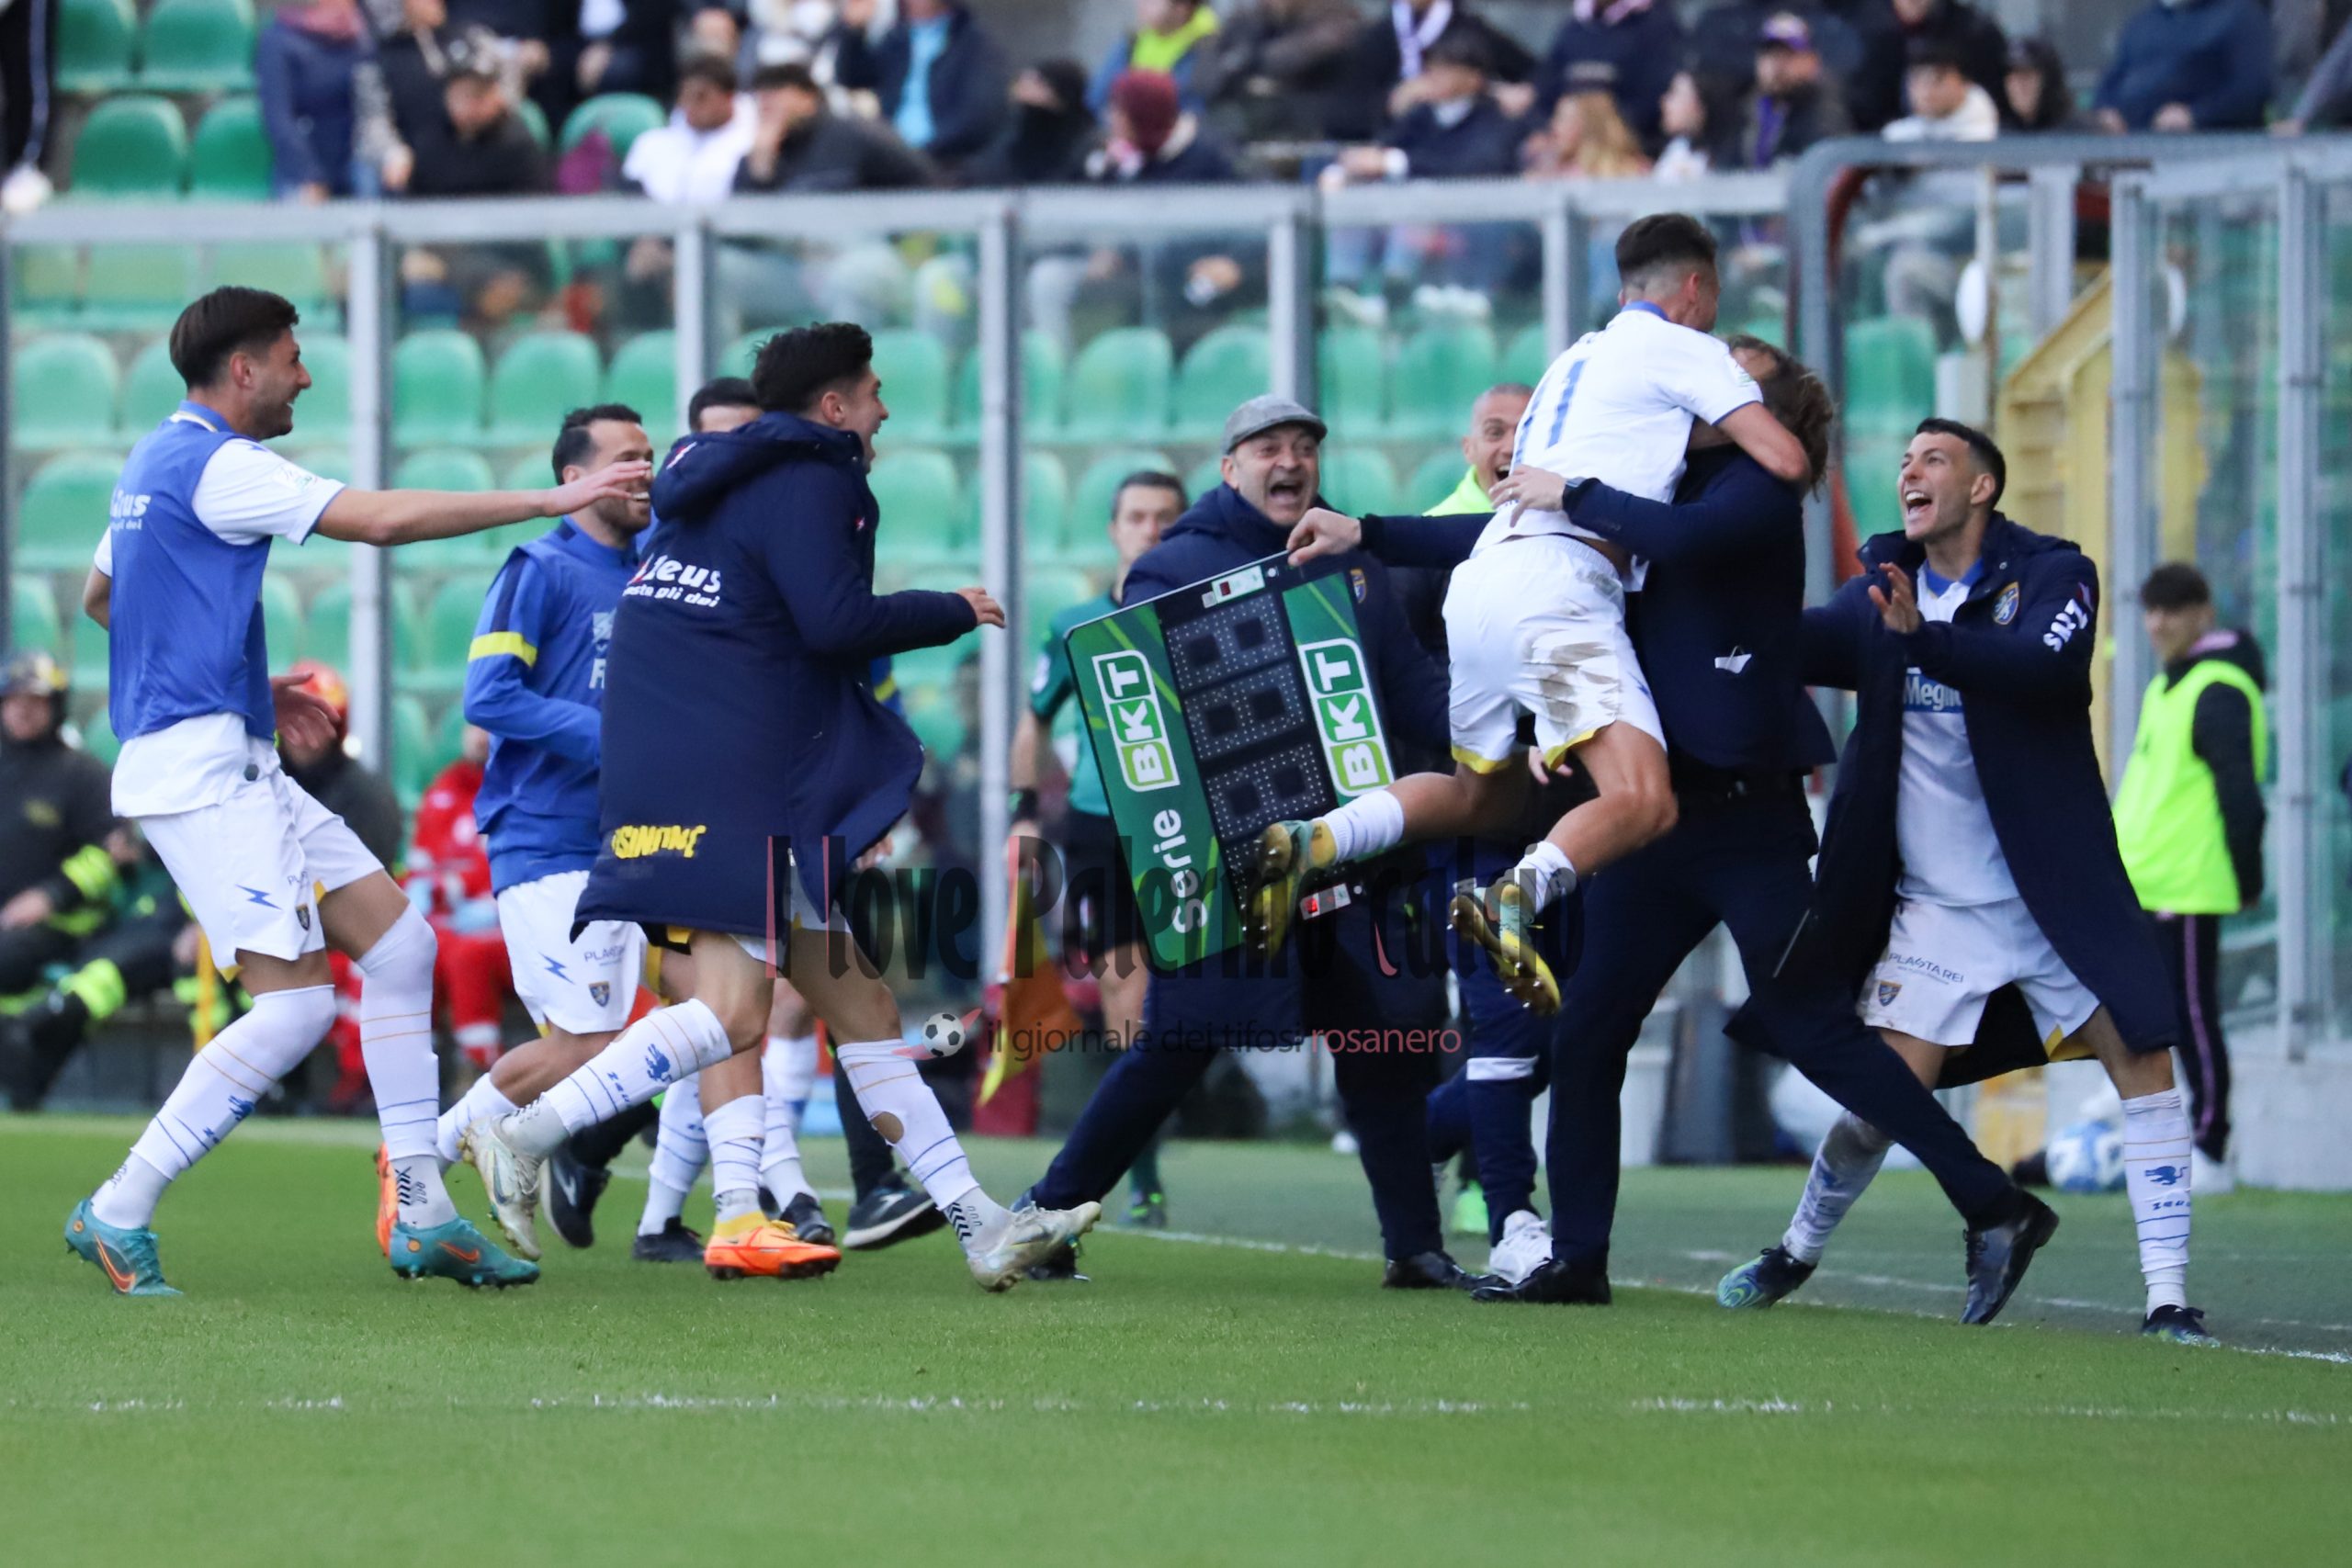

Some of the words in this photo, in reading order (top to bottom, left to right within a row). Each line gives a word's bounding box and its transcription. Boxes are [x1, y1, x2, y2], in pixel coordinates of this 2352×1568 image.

[1103, 659, 1168, 785] BKT
[1312, 650, 1385, 788] BKT
[1152, 808, 1208, 934] Serie
